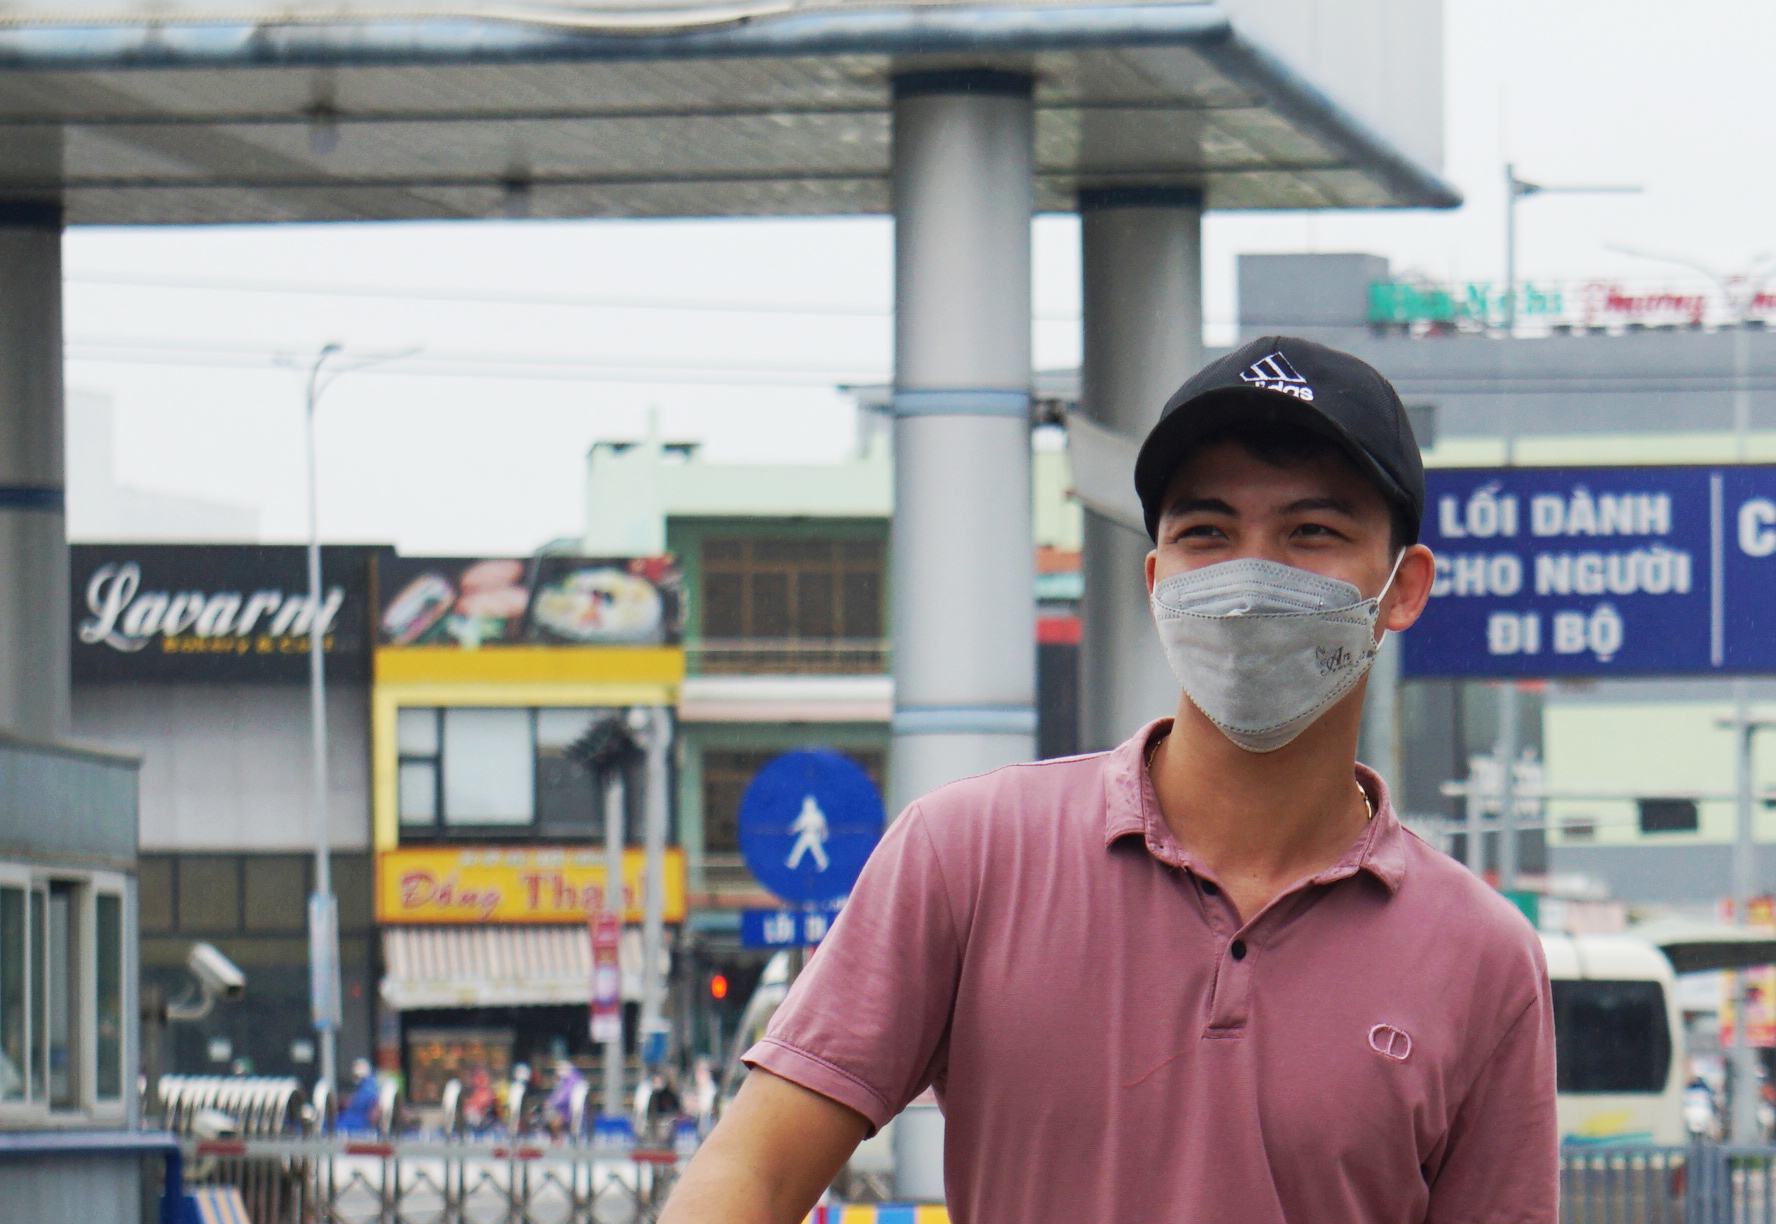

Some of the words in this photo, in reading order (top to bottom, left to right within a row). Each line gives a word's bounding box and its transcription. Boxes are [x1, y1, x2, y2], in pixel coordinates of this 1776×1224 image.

[1439, 478, 1518, 538] LỐI
[1530, 484, 1672, 537] DÀNH
[1430, 552, 1522, 597] CHO
[1534, 541, 1692, 596] NGƯỜI
[1487, 610, 1541, 655] ĐI
[1553, 602, 1624, 663] BỘ
